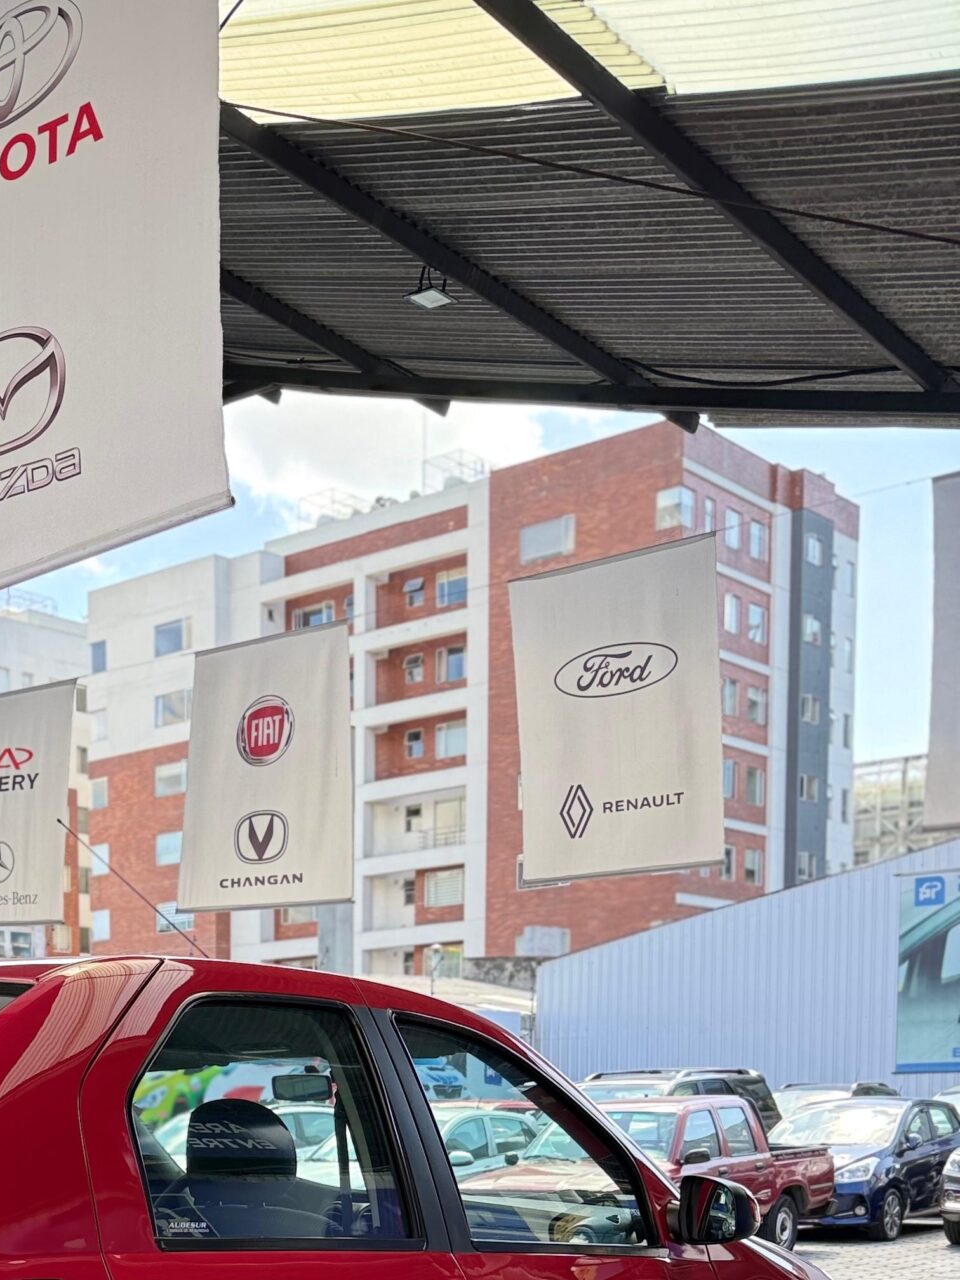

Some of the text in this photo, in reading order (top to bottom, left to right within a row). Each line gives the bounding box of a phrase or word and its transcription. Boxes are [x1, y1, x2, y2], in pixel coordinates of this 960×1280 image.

[576, 650, 653, 692] Ford
[250, 714, 284, 748] FIAT
[602, 792, 685, 814] RENAULT
[219, 873, 304, 889] CHANGAN
